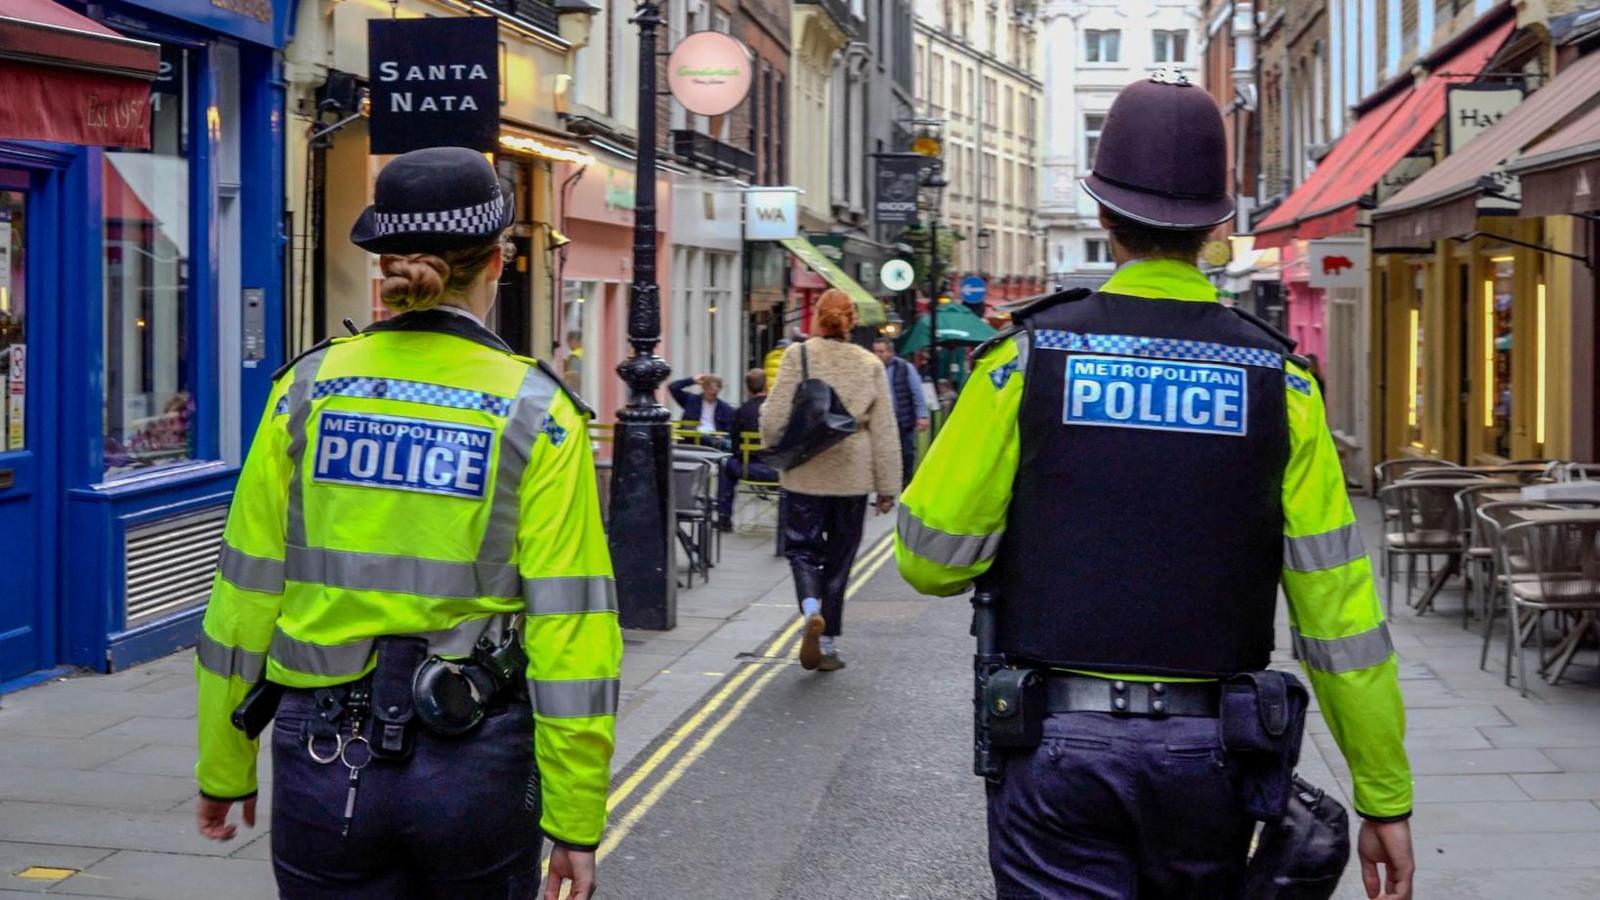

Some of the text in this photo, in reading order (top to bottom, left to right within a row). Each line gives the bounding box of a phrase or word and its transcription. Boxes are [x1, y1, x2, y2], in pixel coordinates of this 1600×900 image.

[380, 61, 488, 82] SANTA
[86, 95, 109, 128] Est
[390, 92, 479, 112] NATA
[755, 207, 787, 223] WA
[1074, 362, 1239, 386] METROPOLITAN
[1071, 379, 1240, 428] POLICE
[324, 417, 487, 448] METROPOLITAN
[317, 435, 484, 491] POLICE
